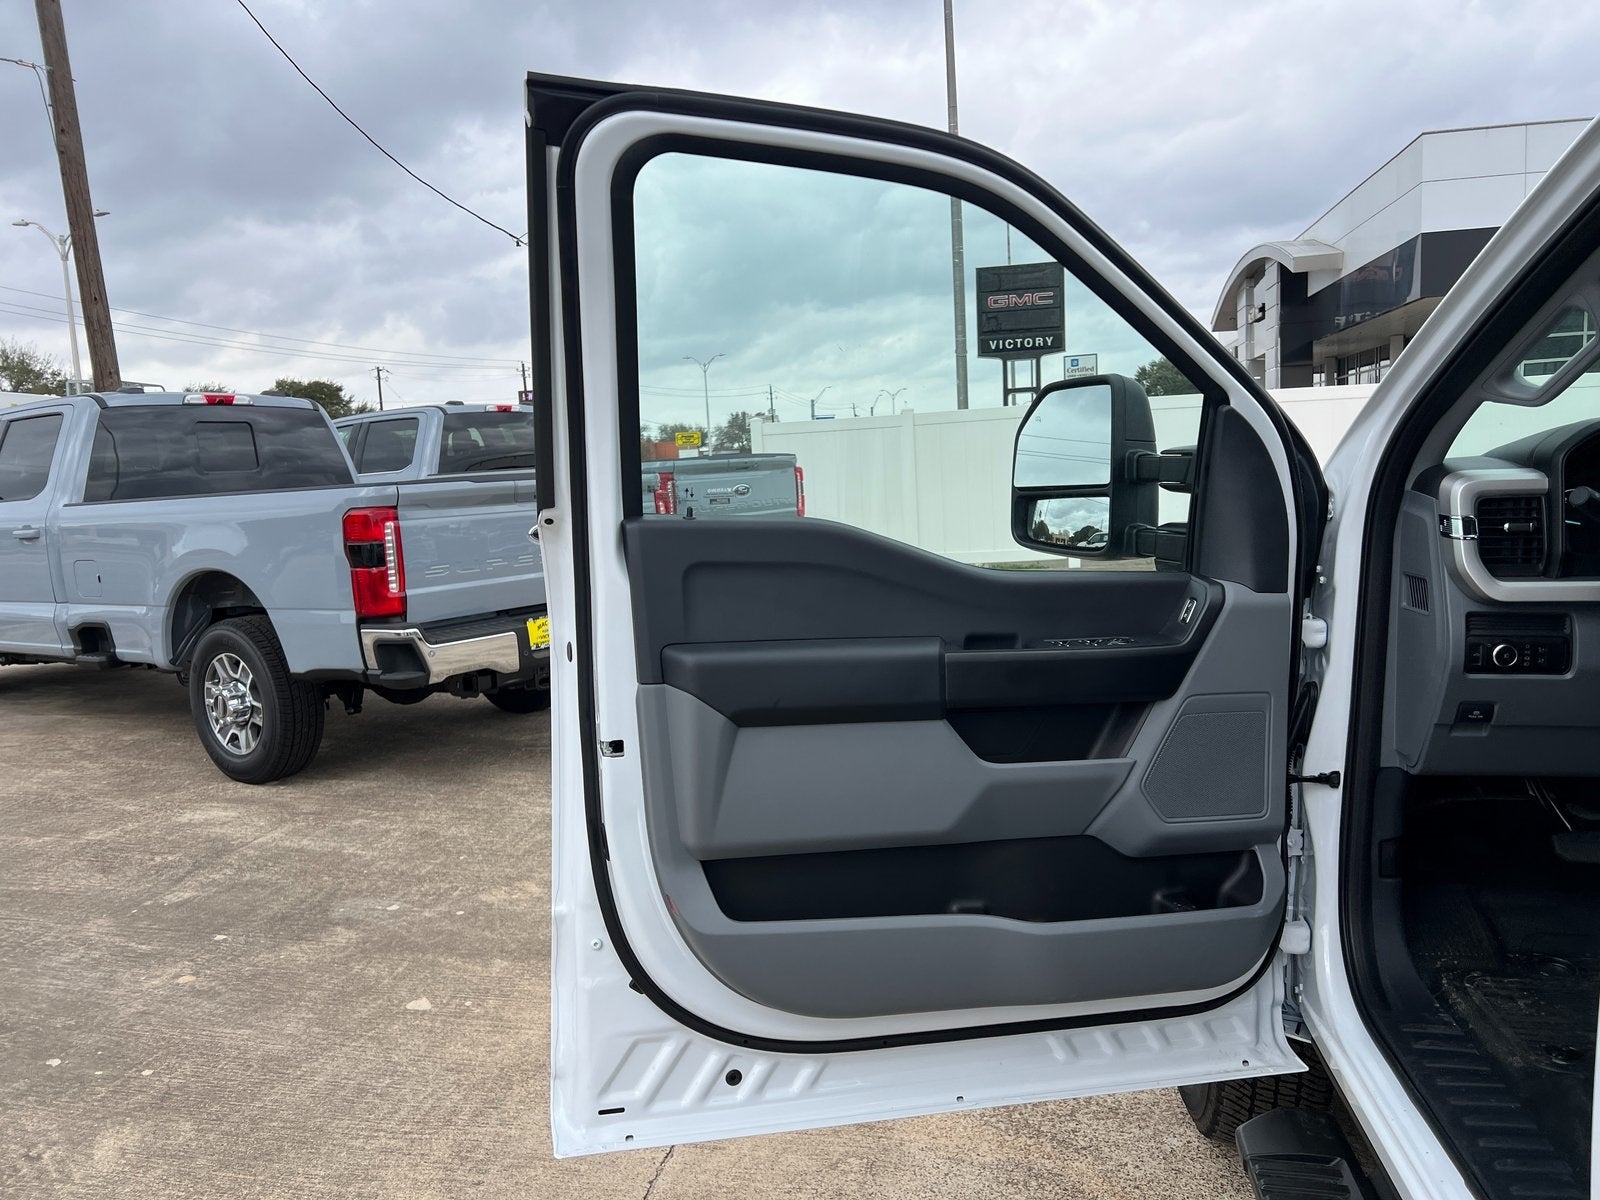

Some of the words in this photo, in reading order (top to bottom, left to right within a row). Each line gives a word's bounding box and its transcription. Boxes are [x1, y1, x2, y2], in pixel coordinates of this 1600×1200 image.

[987, 291, 1054, 309] GMC
[989, 336, 1054, 350] VICTORY
[1066, 366, 1095, 374] Certified
[425, 554, 542, 578] SUPE
